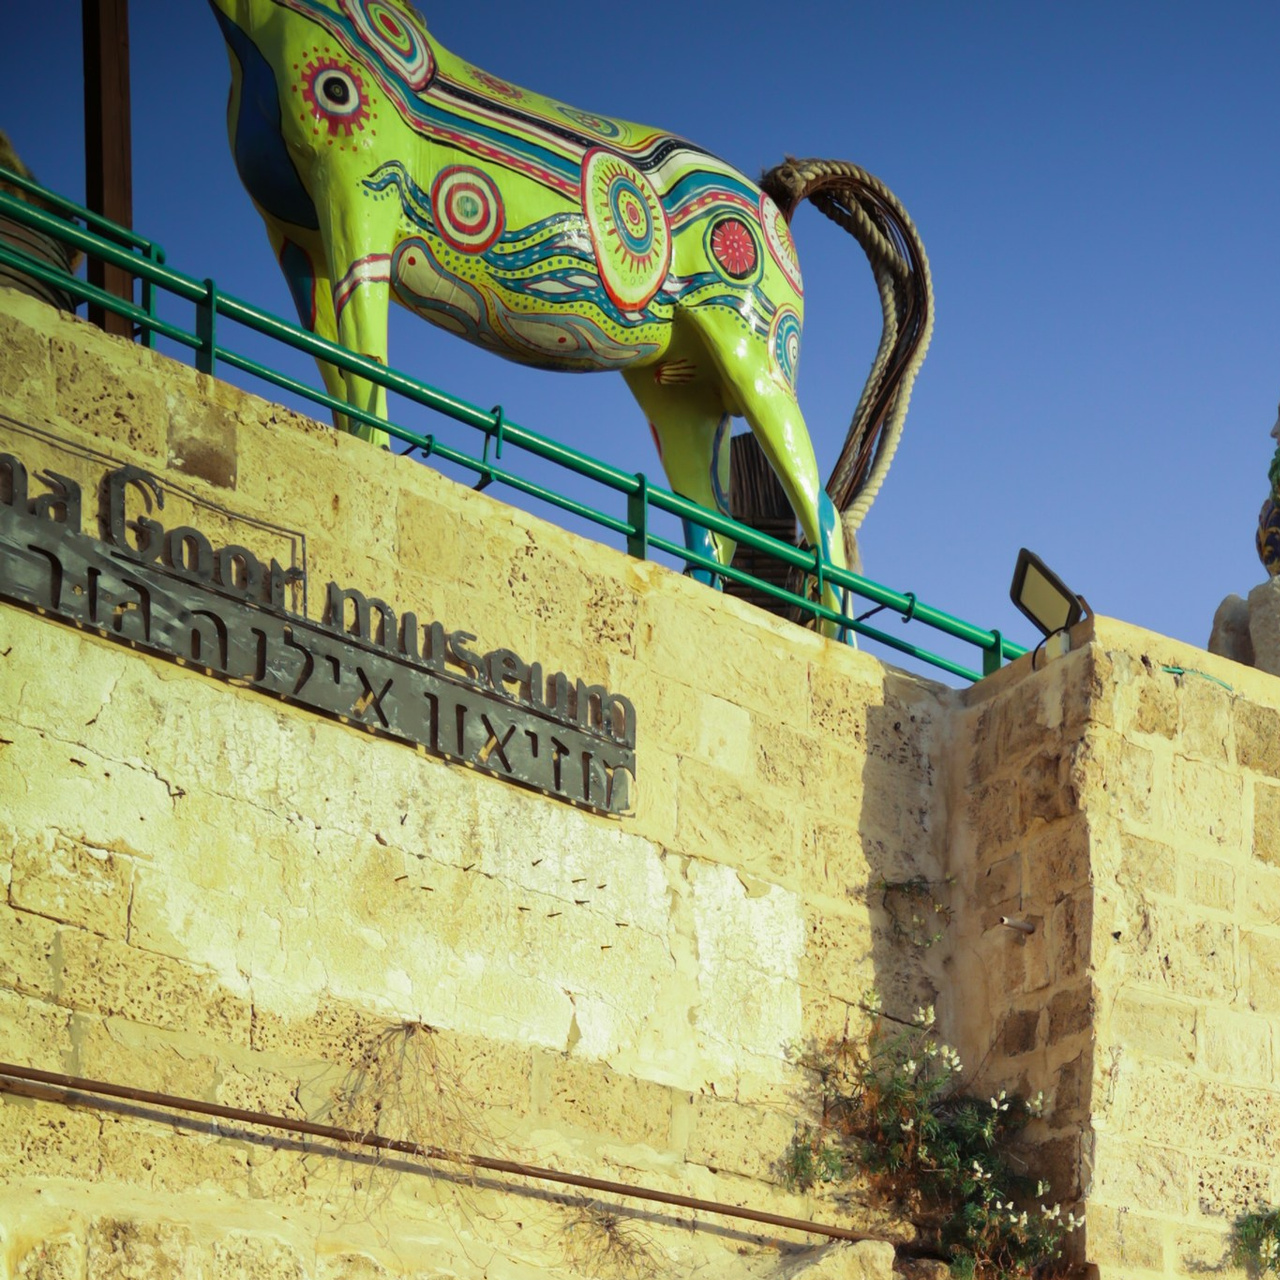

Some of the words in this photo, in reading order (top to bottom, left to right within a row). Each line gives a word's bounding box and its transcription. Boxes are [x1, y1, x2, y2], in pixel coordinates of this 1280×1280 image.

[27, 543, 151, 643] גור
[104, 463, 304, 618] Goor
[326, 581, 637, 750] museum
[190, 609, 394, 729] אילנה
[423, 691, 637, 812] מוזיאון
